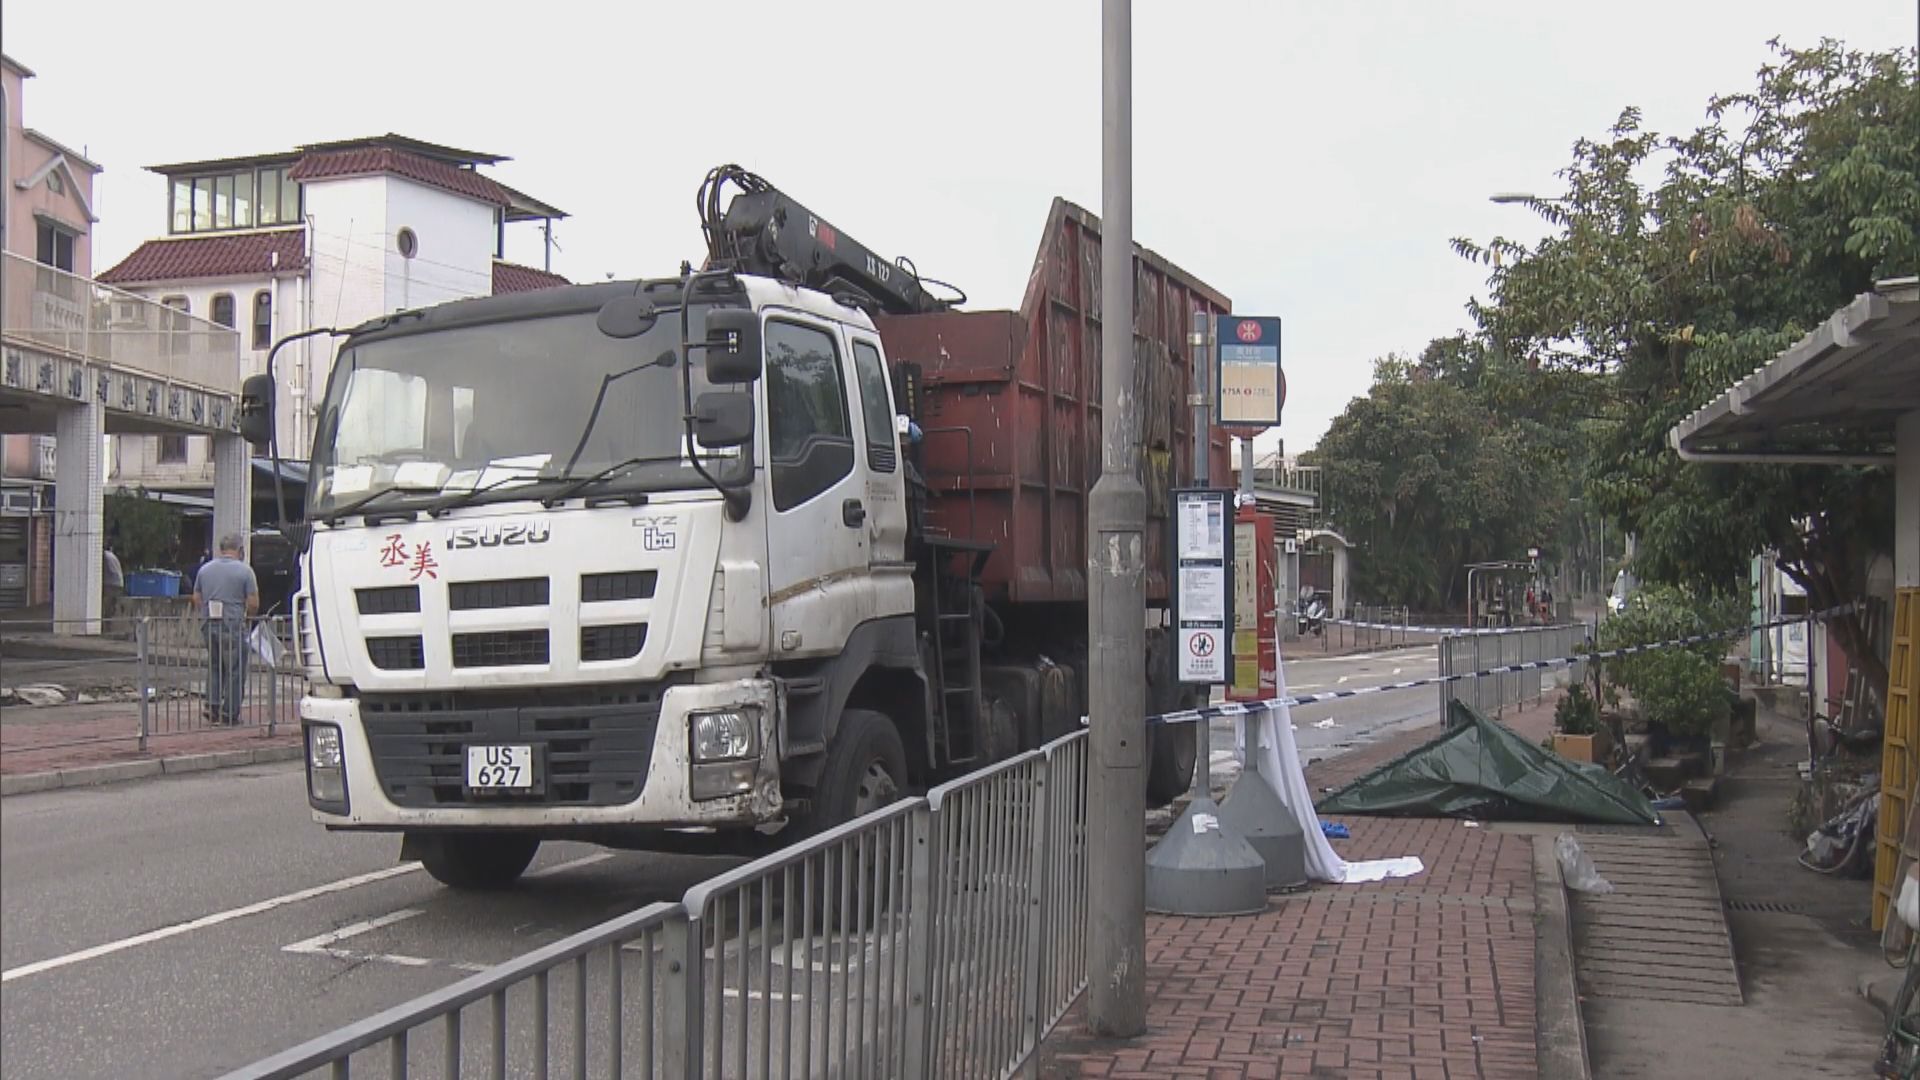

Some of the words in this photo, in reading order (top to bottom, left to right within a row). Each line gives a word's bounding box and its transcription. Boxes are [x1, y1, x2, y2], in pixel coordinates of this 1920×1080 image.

[632, 516, 678, 527] CYZ
[446, 518, 551, 550] ISUZU
[486, 747, 513, 766] US
[478, 766, 521, 786] 627
